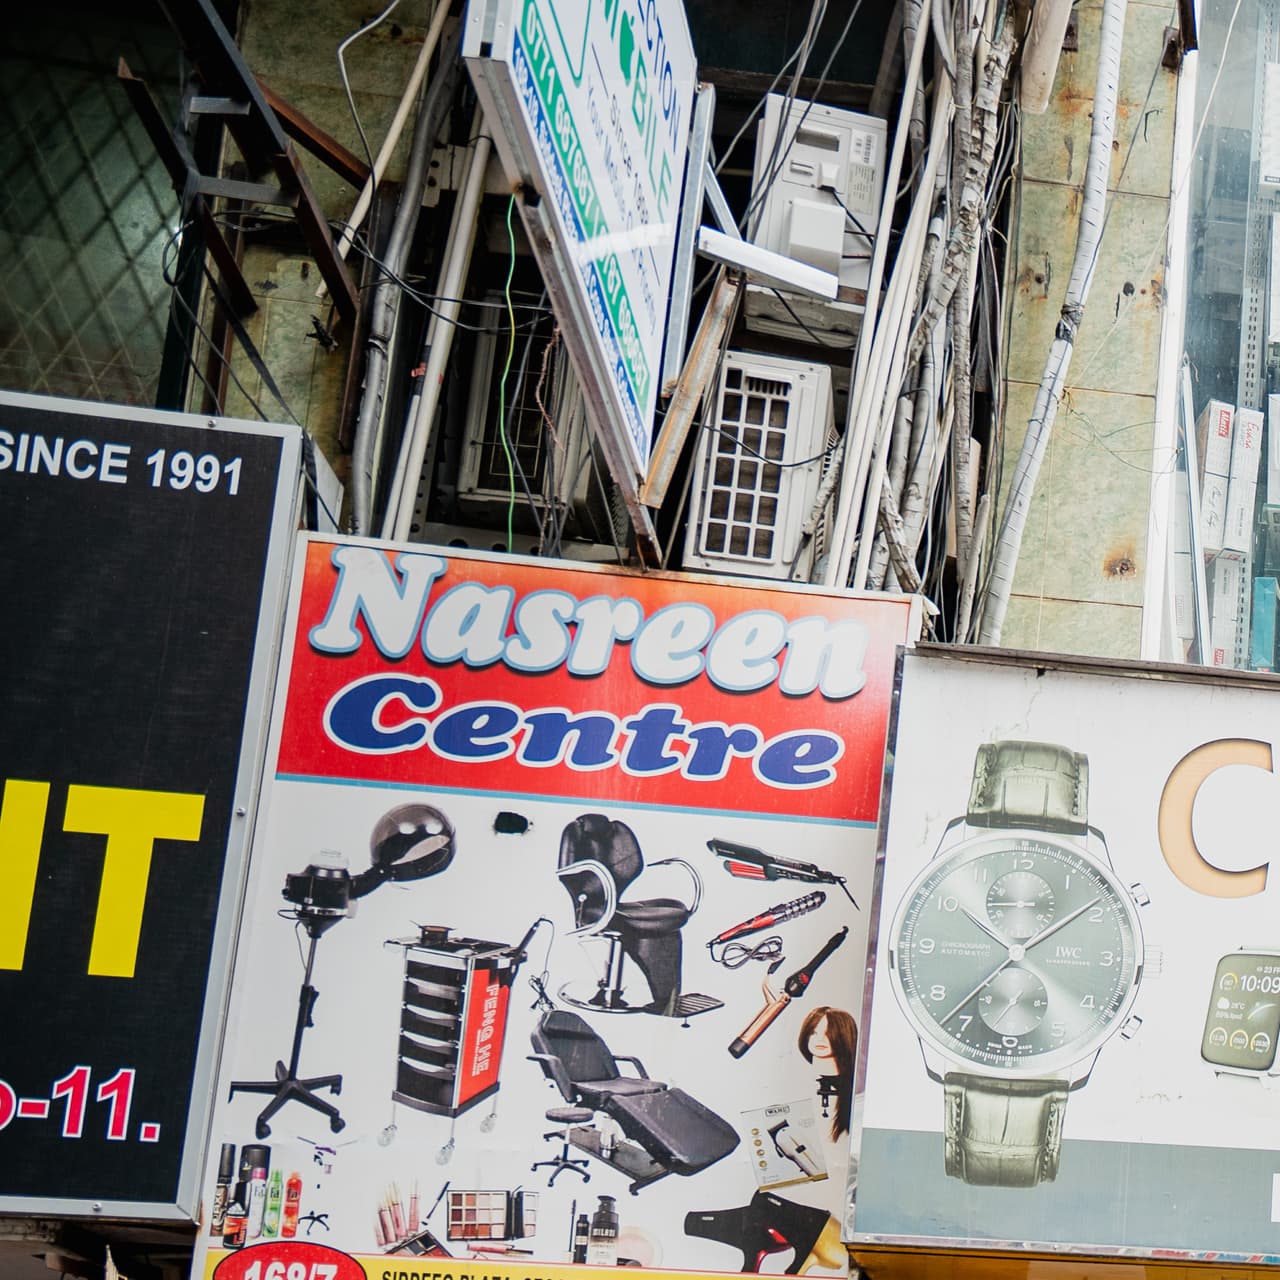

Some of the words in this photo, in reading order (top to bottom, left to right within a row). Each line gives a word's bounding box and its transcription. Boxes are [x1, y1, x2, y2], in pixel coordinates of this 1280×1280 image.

[0, 432, 129, 486] SINCE
[145, 449, 245, 497] 1991
[310, 546, 868, 701] Nasreen
[325, 674, 849, 792] Centre
[1055, 946, 1082, 959] IWC
[0, 1063, 161, 1143] -11.
